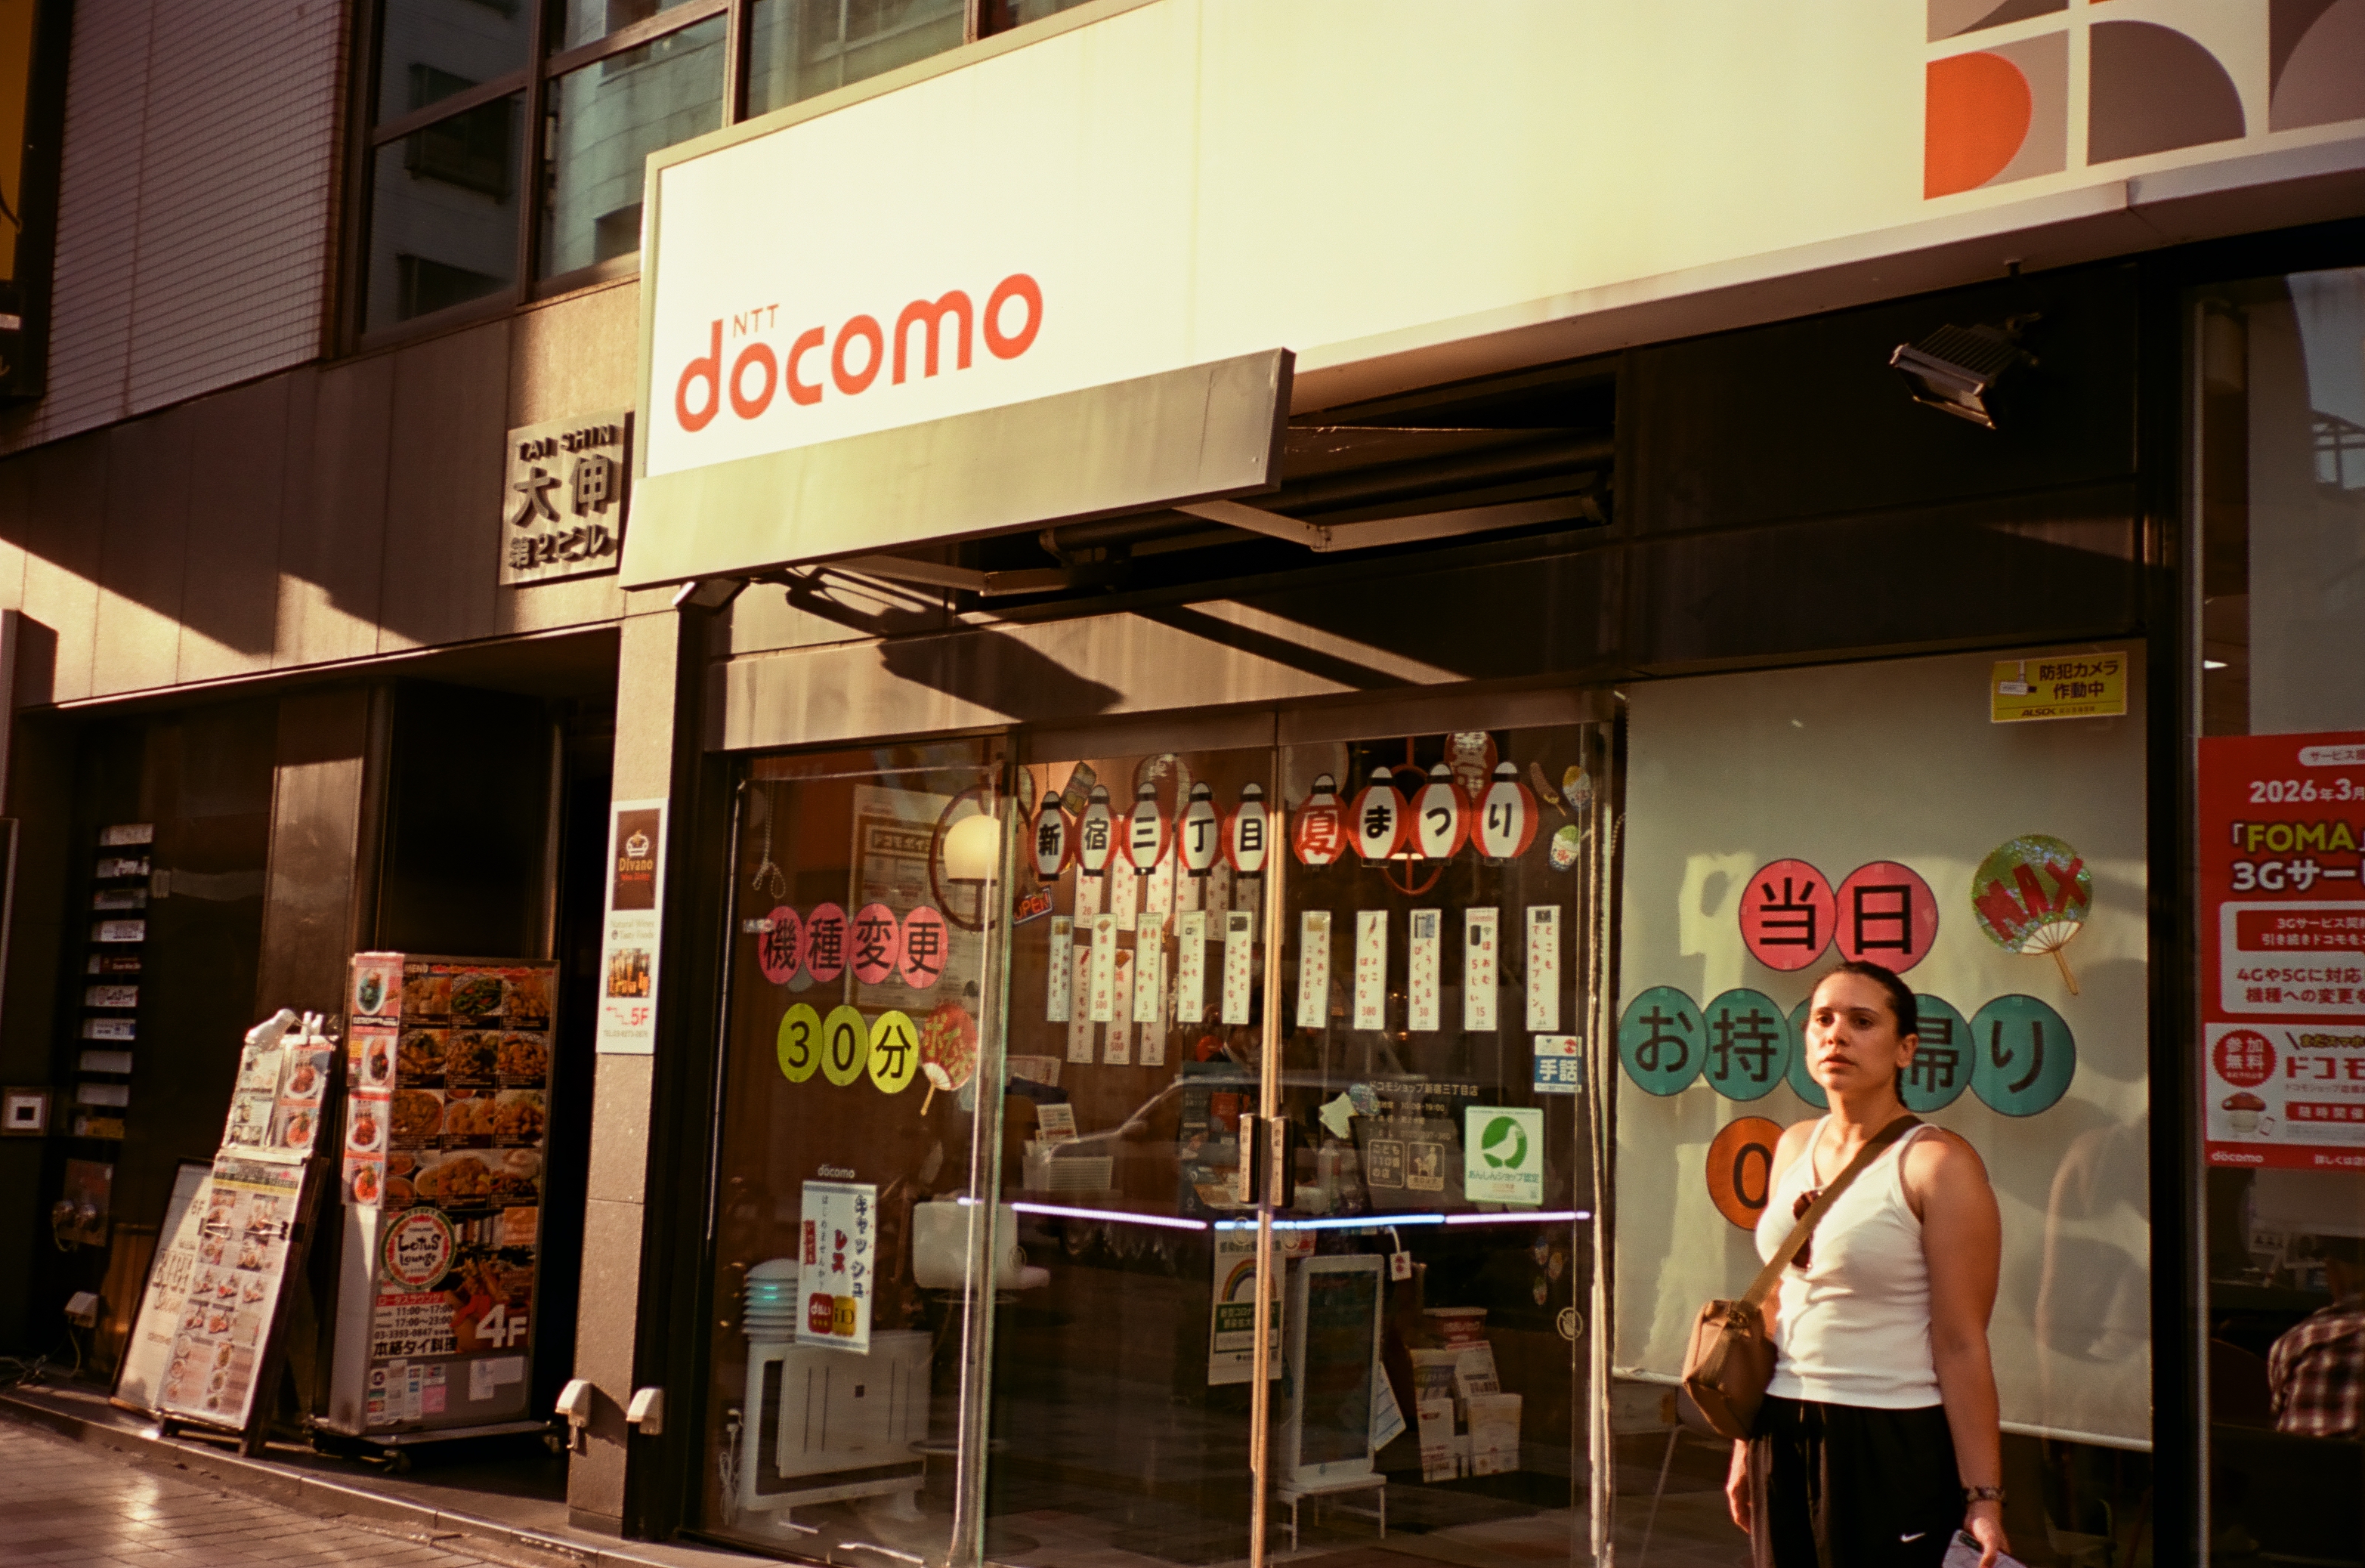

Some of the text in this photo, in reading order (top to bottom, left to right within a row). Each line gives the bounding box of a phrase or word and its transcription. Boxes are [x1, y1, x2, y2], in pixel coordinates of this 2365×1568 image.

[732, 304, 780, 338] NTT
[675, 273, 1043, 433] docomo
[561, 425, 617, 453] SHIN
[2040, 660, 2119, 681] 防犯カメラ
[2053, 681, 2104, 700] 作動中
[618, 857, 654, 872] Divano
[2232, 859, 2365, 890] 3Gサー
[1974, 857, 2088, 942] MAX
[1759, 877, 1912, 955] 当日
[763, 917, 941, 976] 機種変更
[2261, 932, 2365, 946] 引き続きドコモを
[630, 1007, 650, 1026] 5F
[787, 1020, 911, 1079] 30分
[1634, 1005, 2043, 1093] お持帰り
[1539, 1059, 1578, 1081] 手話
[2212, 1150, 2265, 1163] docomo
[818, 1164, 855, 1179] docomo
[398, 1251, 437, 1267] Lounge
[831, 1229, 848, 1274] レス
[851, 1194, 868, 1298] キャッシュ
[475, 1303, 527, 1348] 4F
[834, 1307, 855, 1325] iD
[373, 1337, 458, 1357] 本格タイ料理
